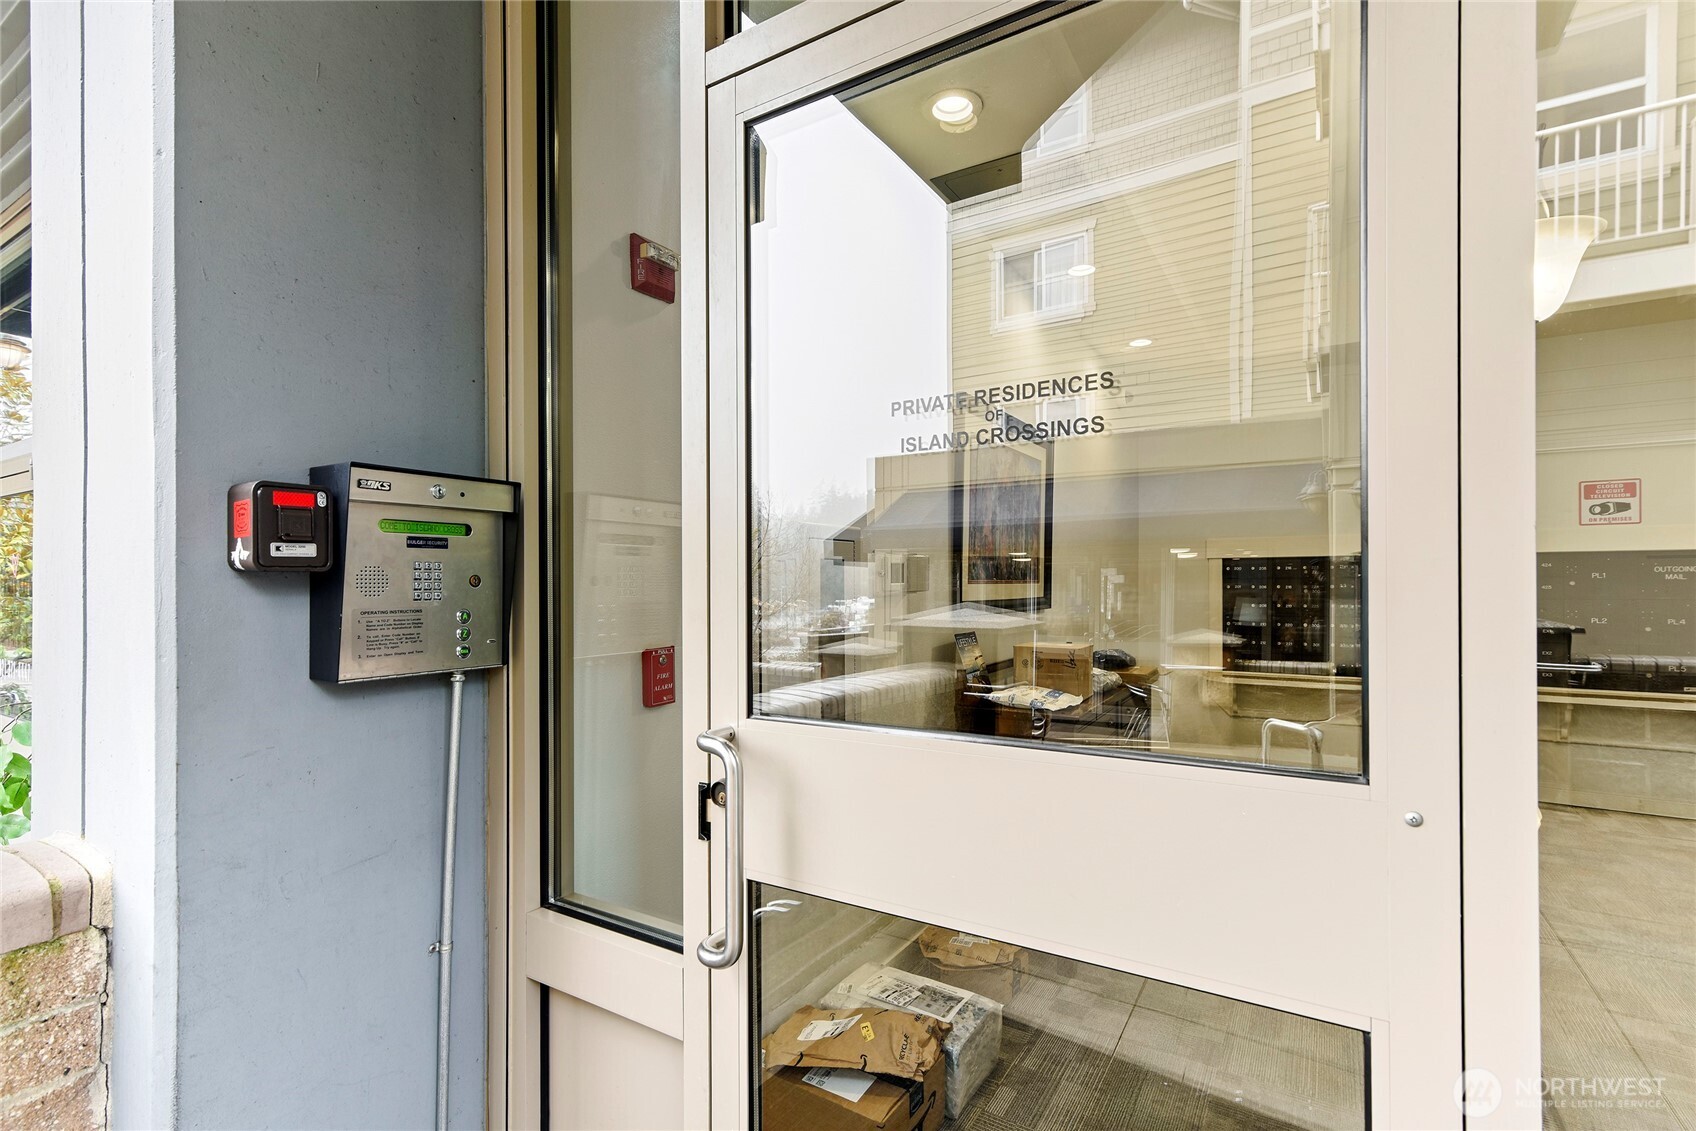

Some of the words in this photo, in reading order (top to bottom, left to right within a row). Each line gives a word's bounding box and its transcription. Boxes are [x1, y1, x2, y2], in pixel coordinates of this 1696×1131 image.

[891, 392, 968, 417] PRIVATE
[974, 371, 1115, 406] RESIDENCES
[985, 409, 1003, 422] OF
[901, 431, 969, 453] ISLAND
[976, 415, 1105, 445] CROSSINGS
[654, 683, 673, 691] ALARM
